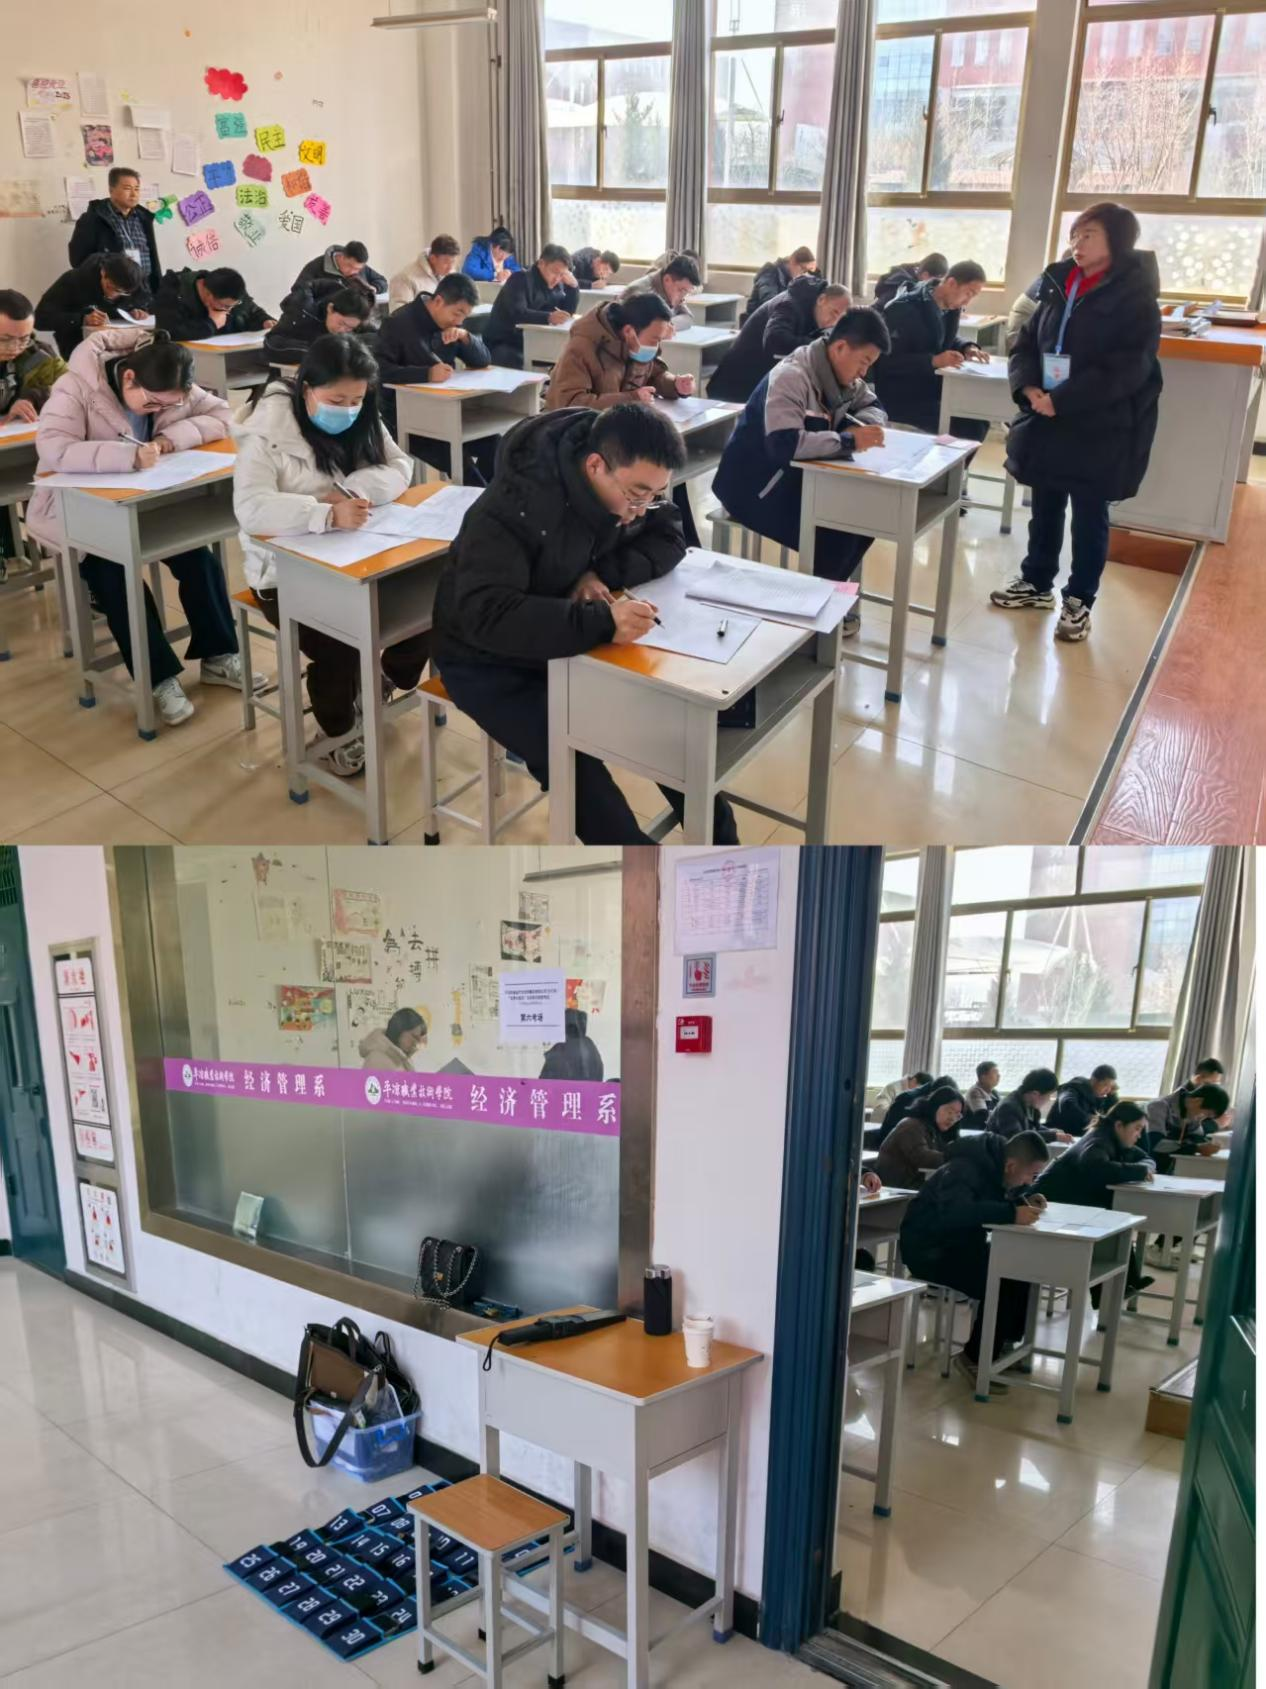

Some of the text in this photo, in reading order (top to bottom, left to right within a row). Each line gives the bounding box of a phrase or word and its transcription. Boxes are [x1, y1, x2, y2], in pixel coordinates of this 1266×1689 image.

[258, 129, 285, 151] 民主
[299, 144, 324, 164] 文明
[239, 187, 267, 205] 法治
[279, 209, 304, 233] 爱国
[243, 1069, 326, 1098] 经济管理系
[469, 1084, 618, 1125] 经济管理系
[371, 1504, 392, 1517] 07
[330, 1515, 349, 1531] 13
[390, 1517, 411, 1529] 08
[289, 1536, 309, 1551] 19
[351, 1534, 371, 1548] 14
[305, 1549, 328, 1564] 20
[369, 1542, 390, 1557] 15
[239, 1552, 262, 1568] 25
[391, 1553, 412, 1568] 16
[454, 1551, 475, 1567] 11
[259, 1566, 281, 1582] 26
[324, 1564, 346, 1578] 21
[277, 1581, 301, 1596] 27
[343, 1574, 366, 1591] 22
[297, 1597, 321, 1612] 28
[317, 1609, 342, 1625] 29
[340, 1628, 366, 1645] 30
